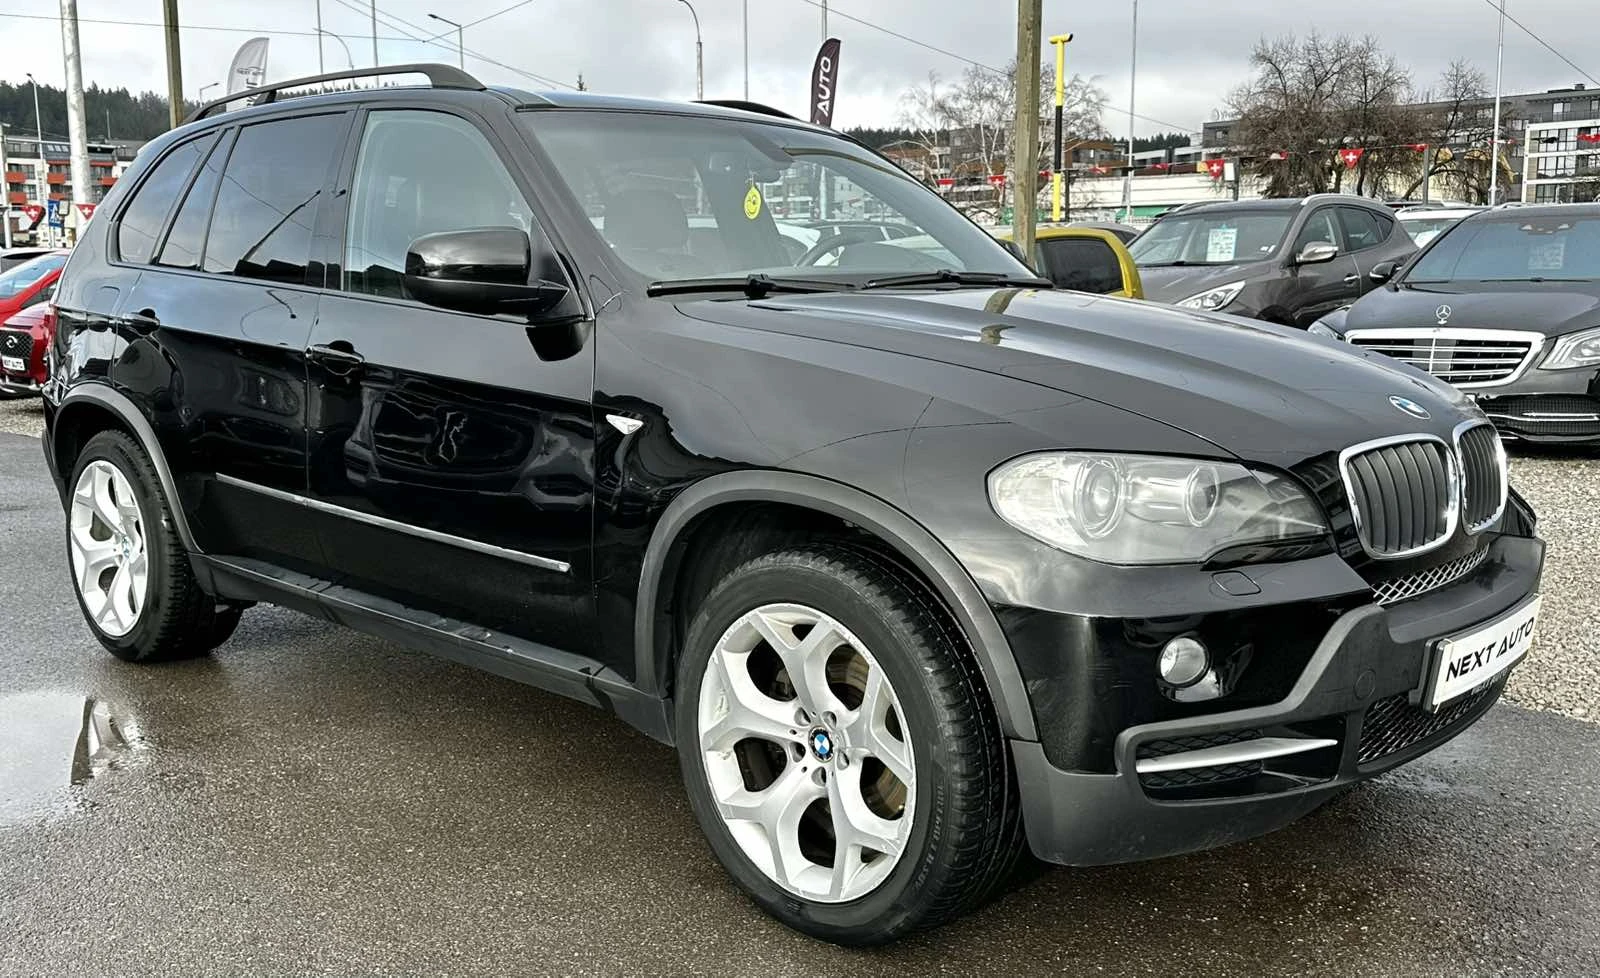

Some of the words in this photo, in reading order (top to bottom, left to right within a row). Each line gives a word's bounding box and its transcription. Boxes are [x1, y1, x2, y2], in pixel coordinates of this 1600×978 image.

[816, 56, 832, 117] AUTO
[1446, 642, 1496, 681] NEXT
[1496, 616, 1535, 658] AUTO
